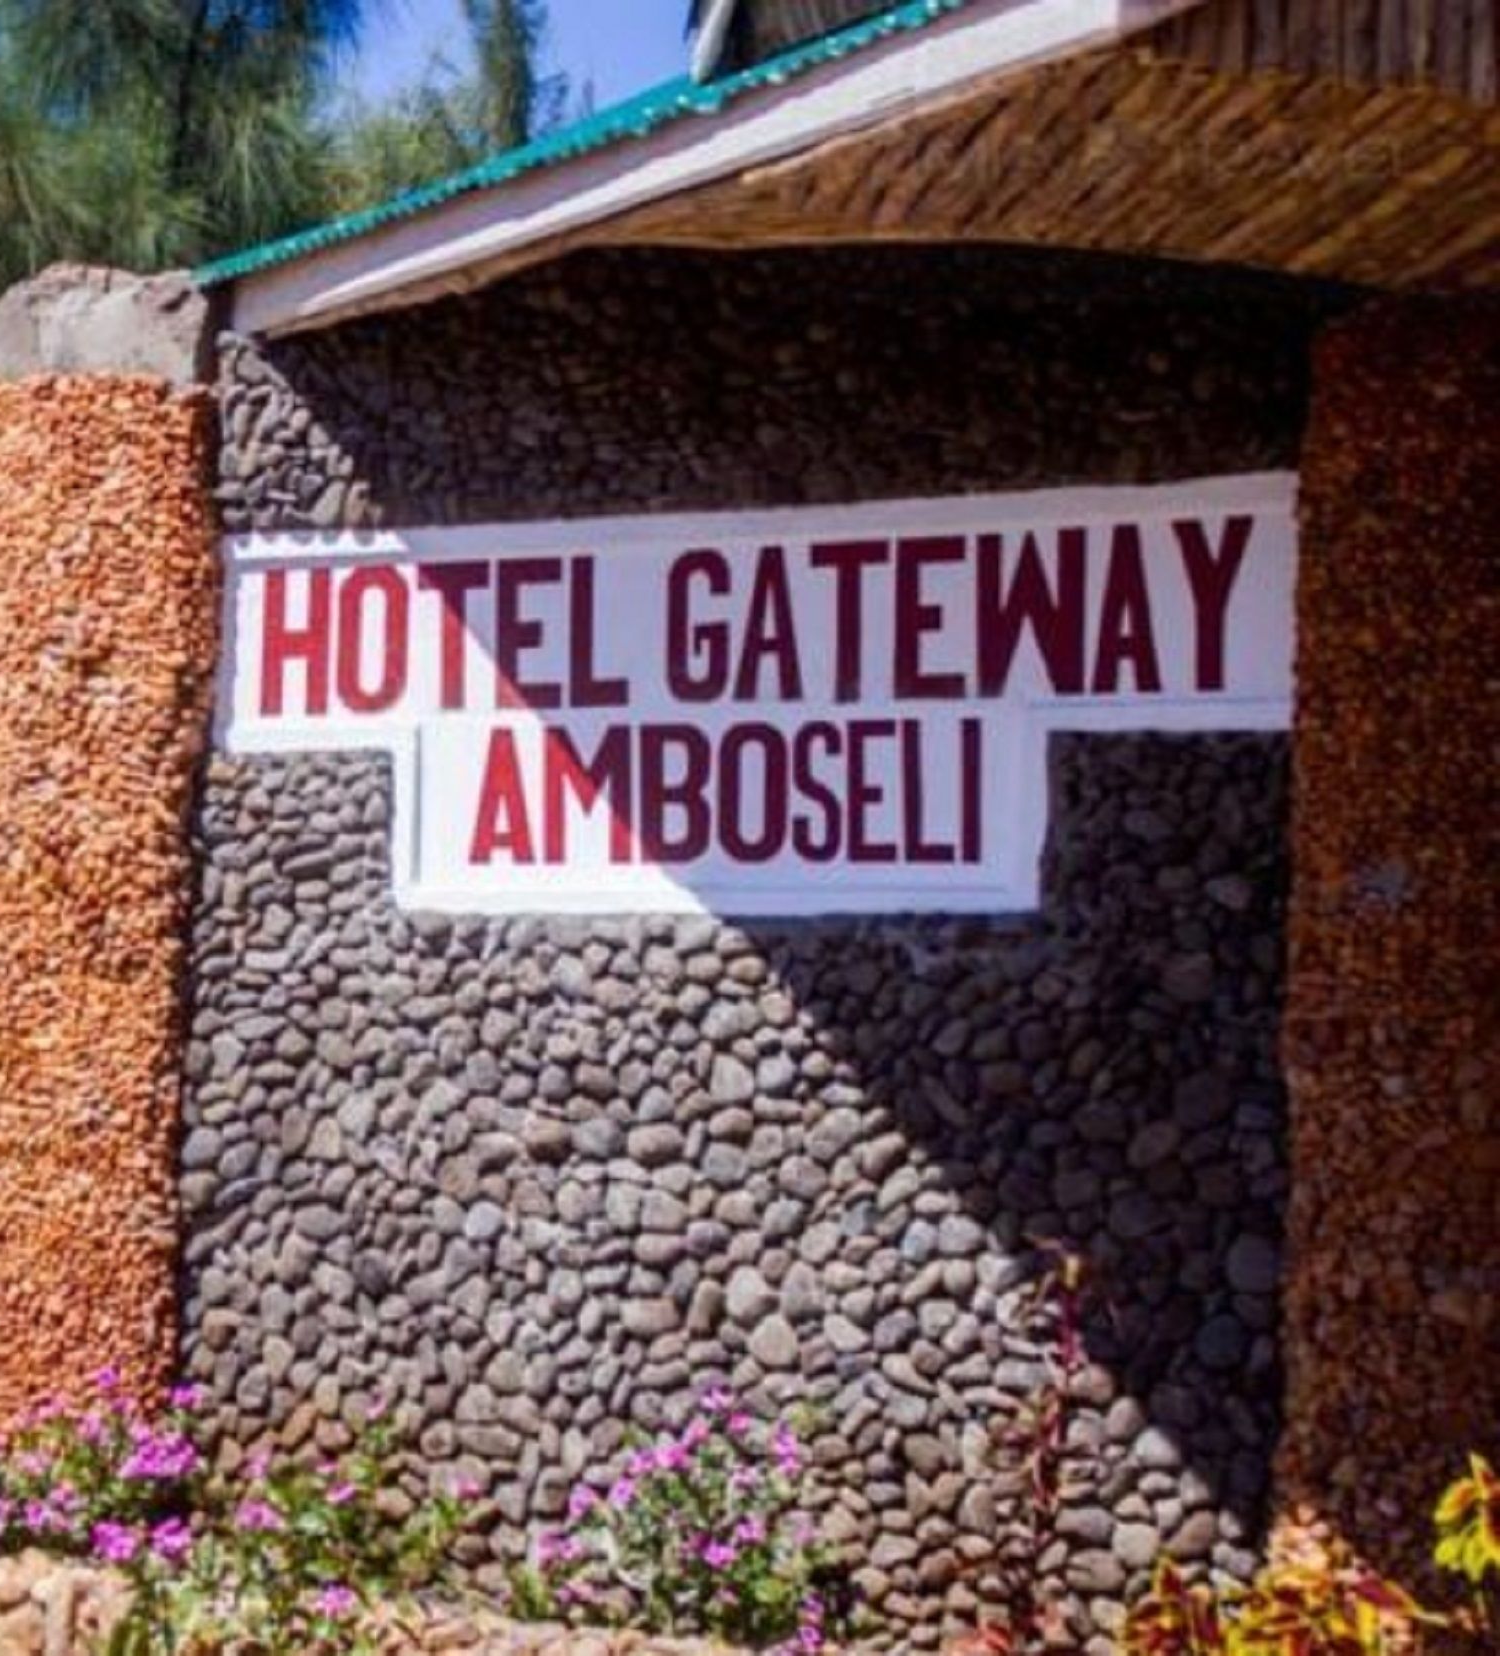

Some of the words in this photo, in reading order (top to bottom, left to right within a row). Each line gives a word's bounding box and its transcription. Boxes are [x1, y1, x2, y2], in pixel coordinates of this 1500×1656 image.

[258, 553, 631, 714] HOTEL
[664, 513, 1256, 705] GATEWAY
[468, 716, 984, 865] AMBOSELI
